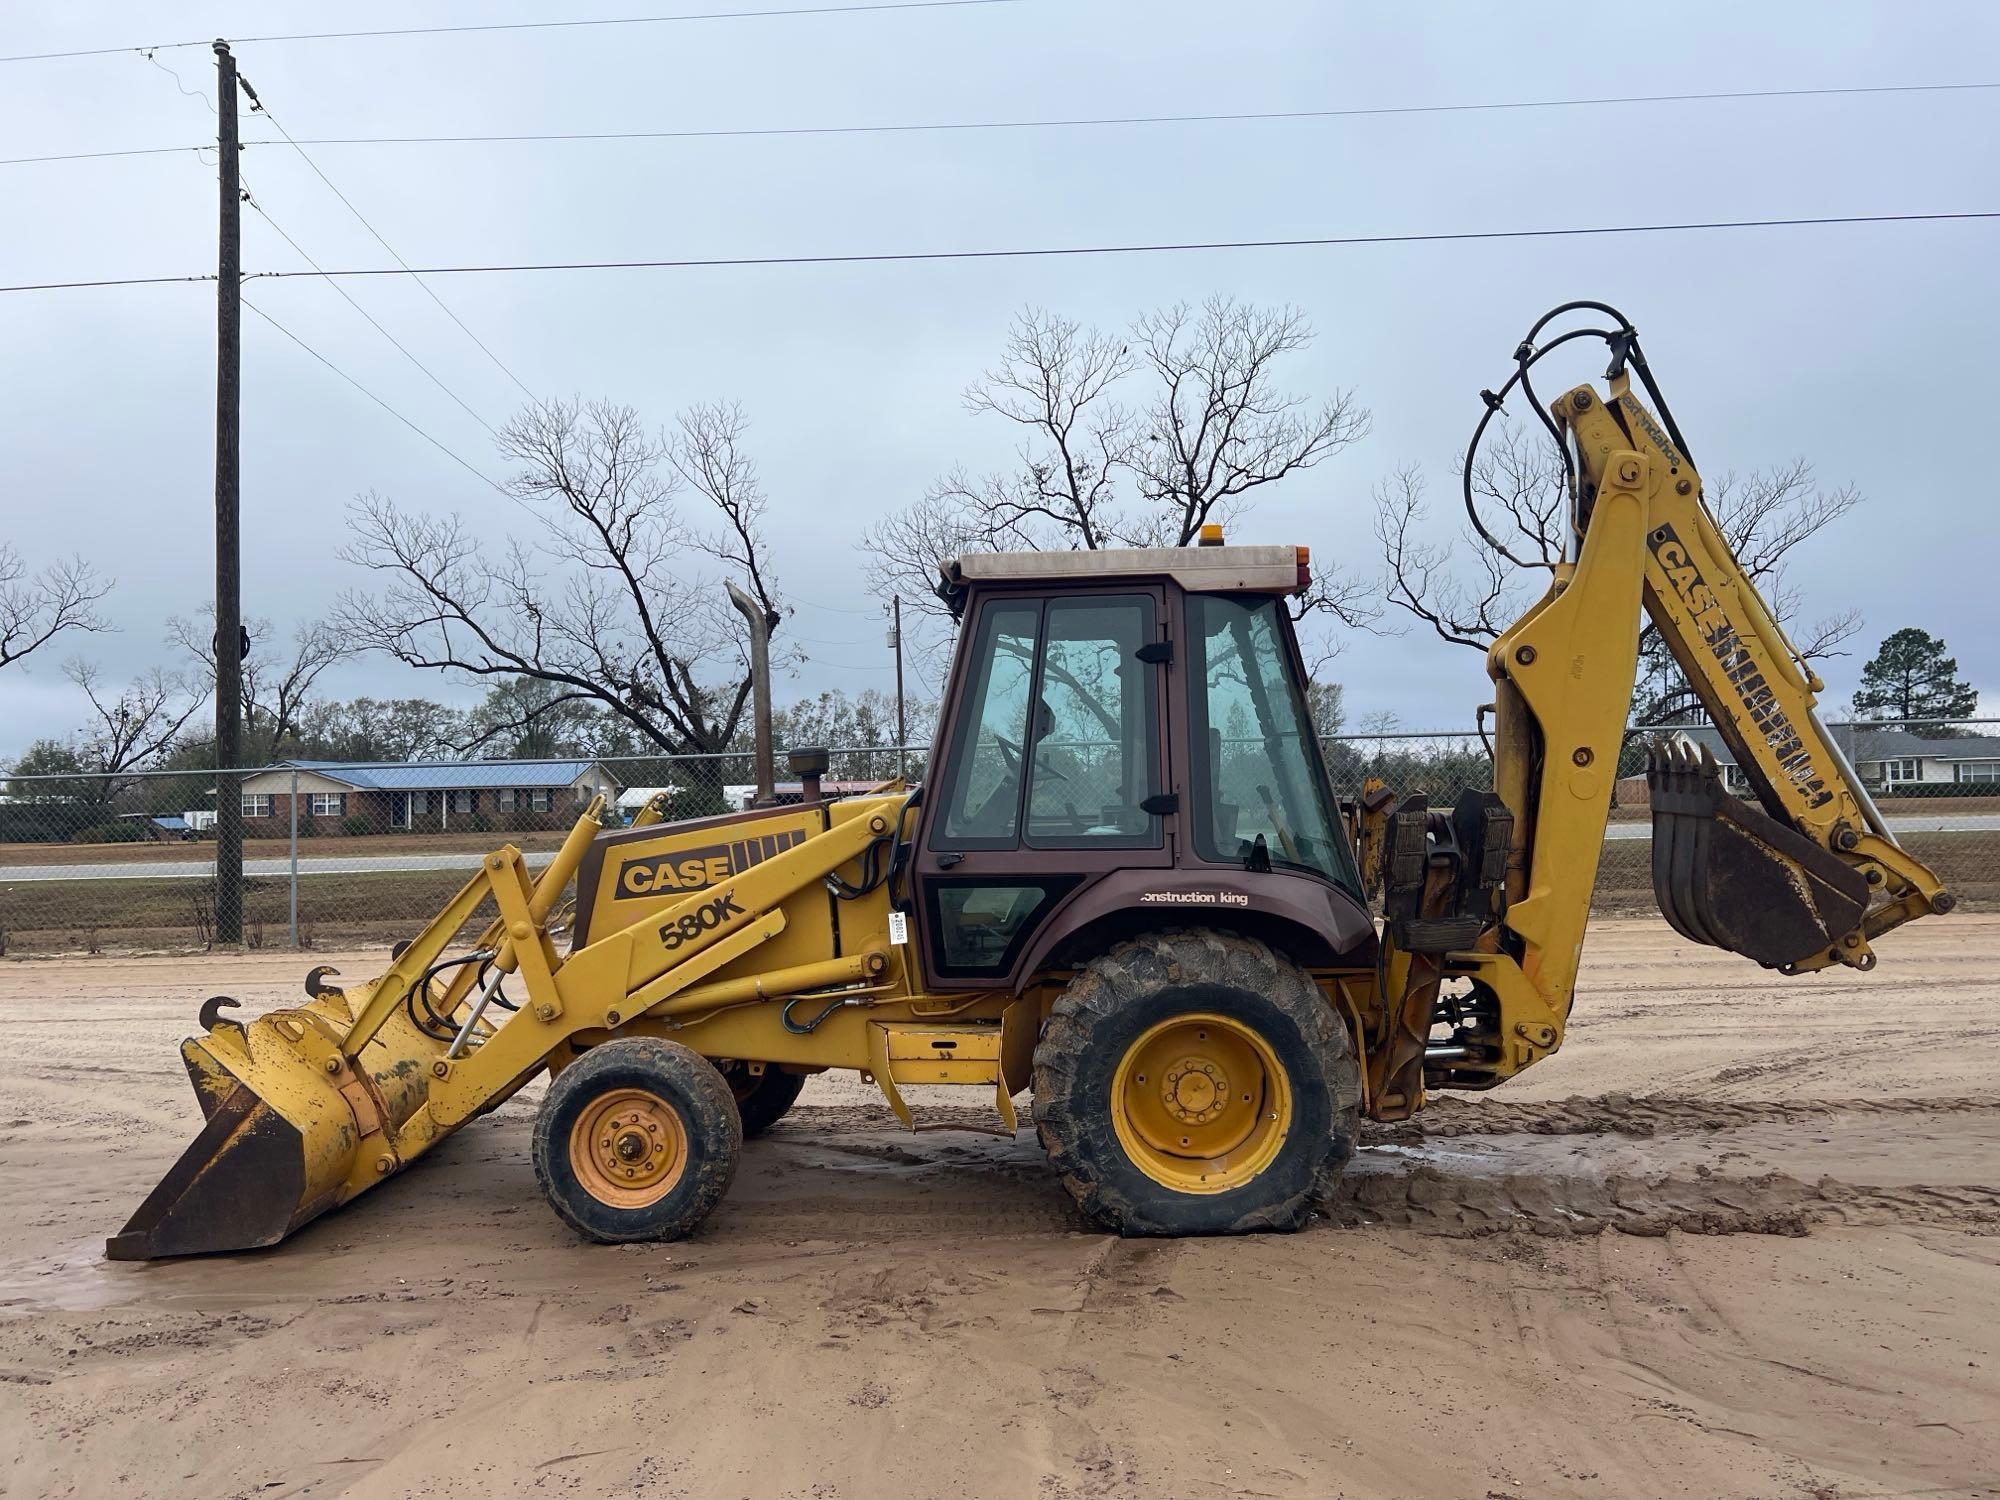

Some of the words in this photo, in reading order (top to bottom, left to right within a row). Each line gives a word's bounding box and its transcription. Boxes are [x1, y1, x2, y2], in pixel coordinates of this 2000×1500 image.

[1657, 541, 1730, 638] CASE
[623, 856, 730, 893] CASE
[1140, 892, 1215, 903] onstruction
[1220, 892, 1248, 906] king
[658, 888, 746, 950] 580K
